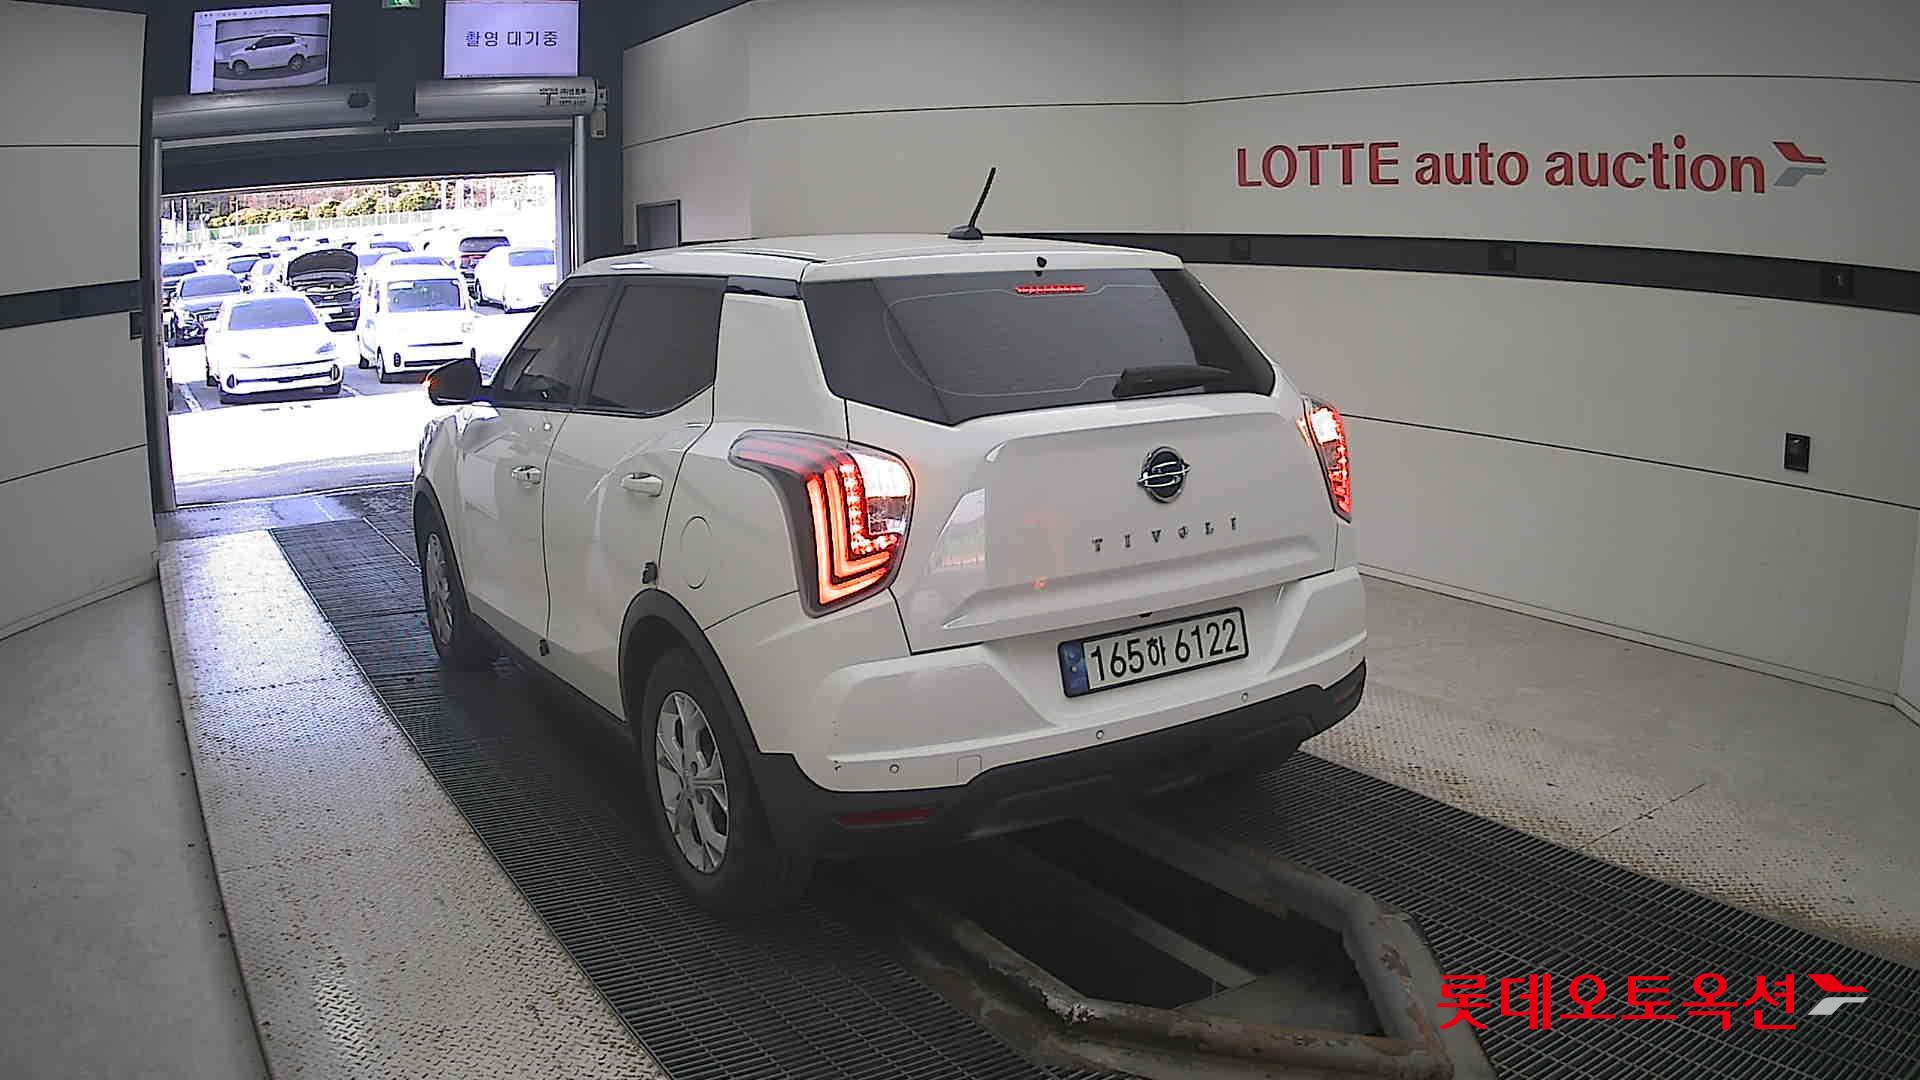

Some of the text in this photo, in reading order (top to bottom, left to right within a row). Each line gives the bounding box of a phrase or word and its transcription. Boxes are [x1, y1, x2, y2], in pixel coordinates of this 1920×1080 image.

[507, 31, 558, 47] 대기중
[1237, 135, 1766, 194] LOTTE auto auction
[1091, 516, 1239, 551] TIVOLI
[1091, 618, 1239, 681] 165하 6122
